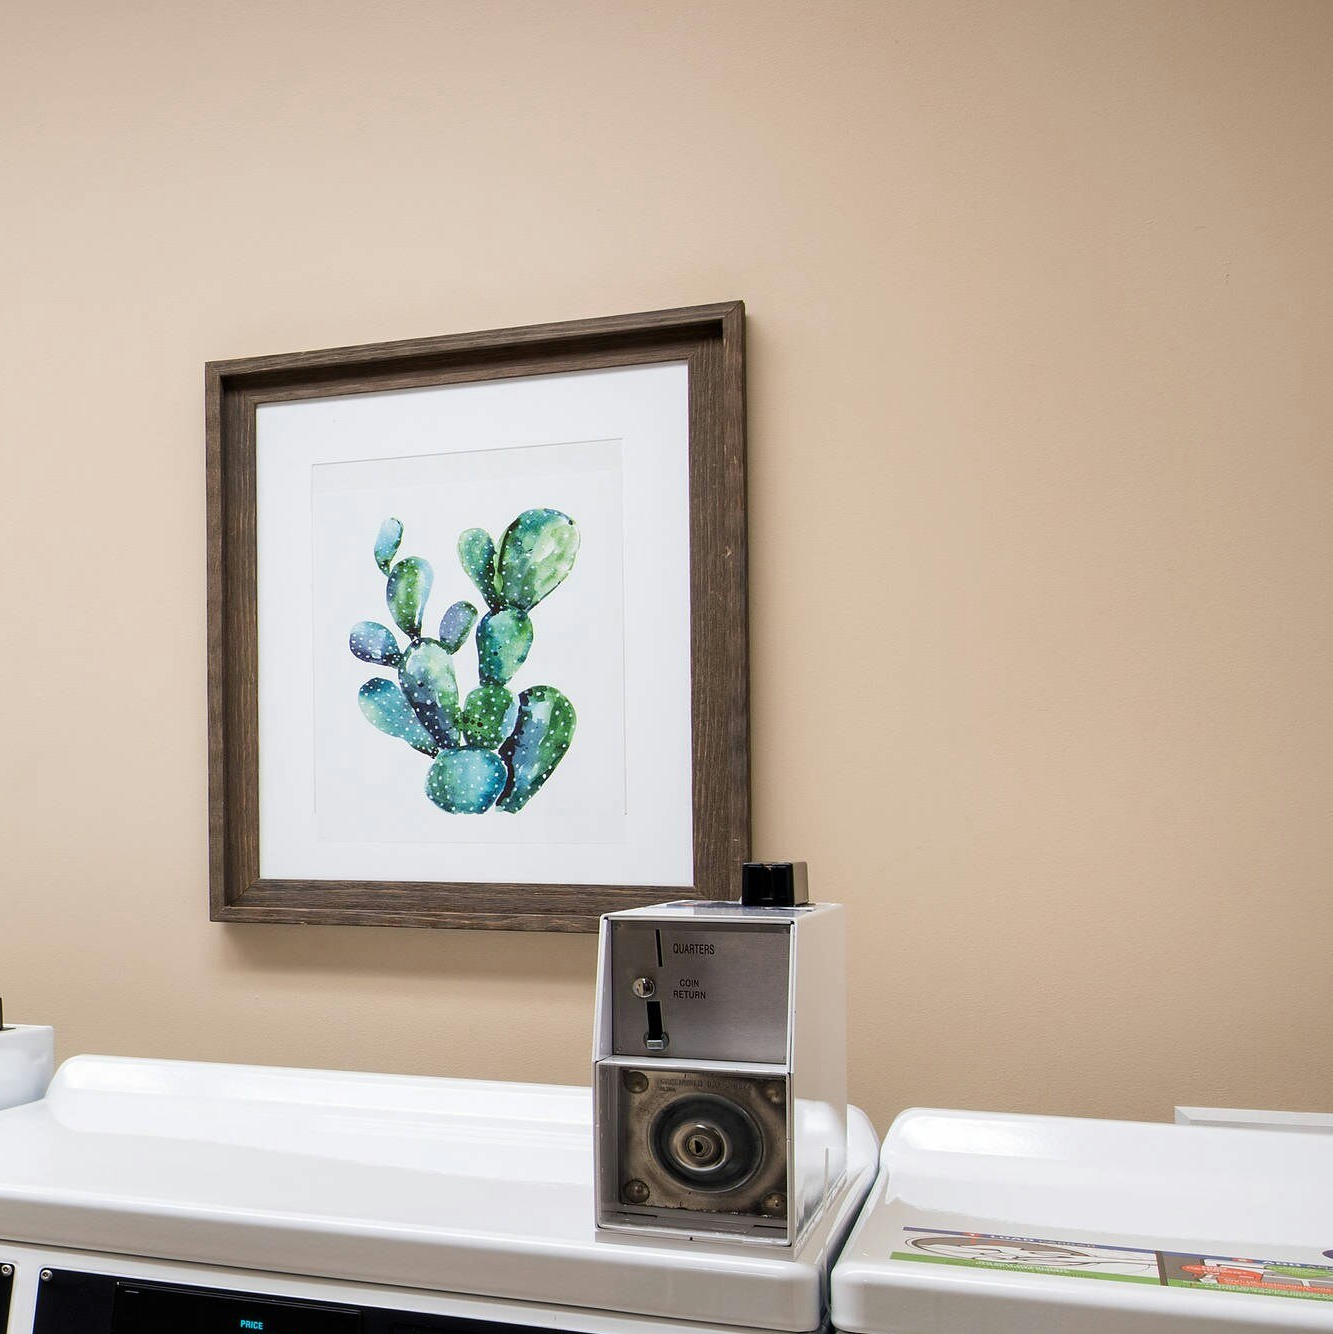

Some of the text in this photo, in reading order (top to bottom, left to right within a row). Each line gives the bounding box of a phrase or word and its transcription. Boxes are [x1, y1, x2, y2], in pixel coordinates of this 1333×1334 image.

[672, 942, 716, 955] QUARTERS
[679, 978, 700, 988] COIN
[673, 990, 706, 1000] RETURN
[240, 1319, 264, 1330] PRICE
